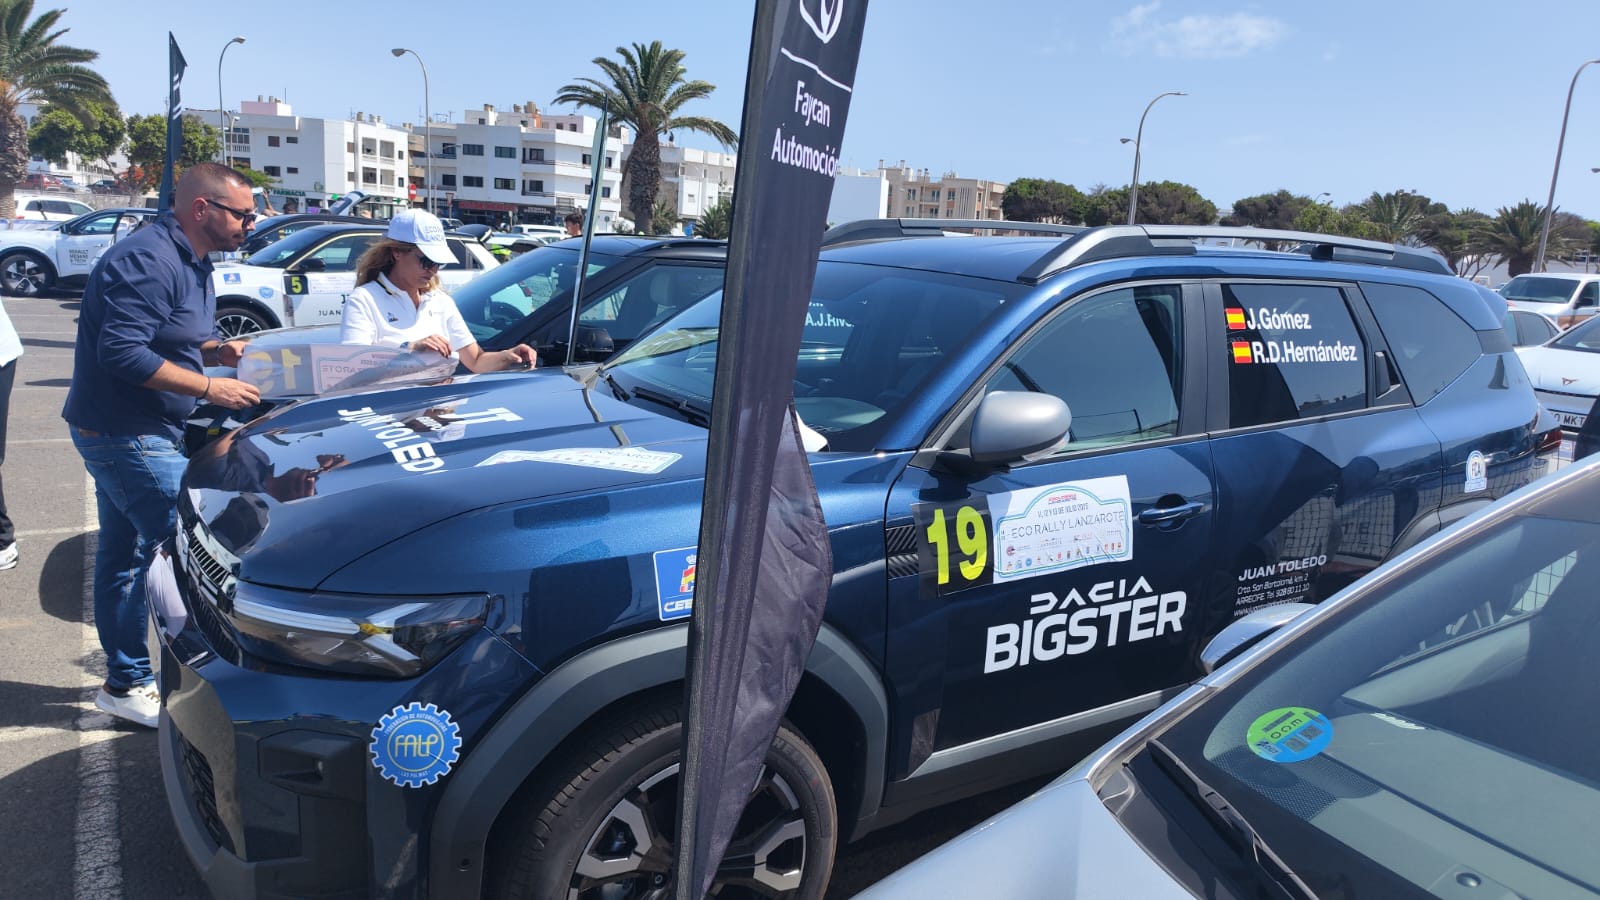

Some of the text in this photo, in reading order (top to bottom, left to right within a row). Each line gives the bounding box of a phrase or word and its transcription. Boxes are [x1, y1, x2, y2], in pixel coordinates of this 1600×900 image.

[795, 80, 831, 128] Faycan
[291, 276, 302, 294] 5
[1246, 307, 1312, 330] J.Gómez
[1251, 340, 1358, 364] R.D.Hernández
[1068, 510, 1125, 529] LANZAROTE
[926, 505, 988, 585] 19
[1238, 554, 1327, 581] JUAN TOLEDO
[664, 598, 693, 612] CEE
[1030, 576, 1153, 615] DACIA
[983, 590, 1188, 675] BIGSTER
[1270, 718, 1303, 740] ECO
